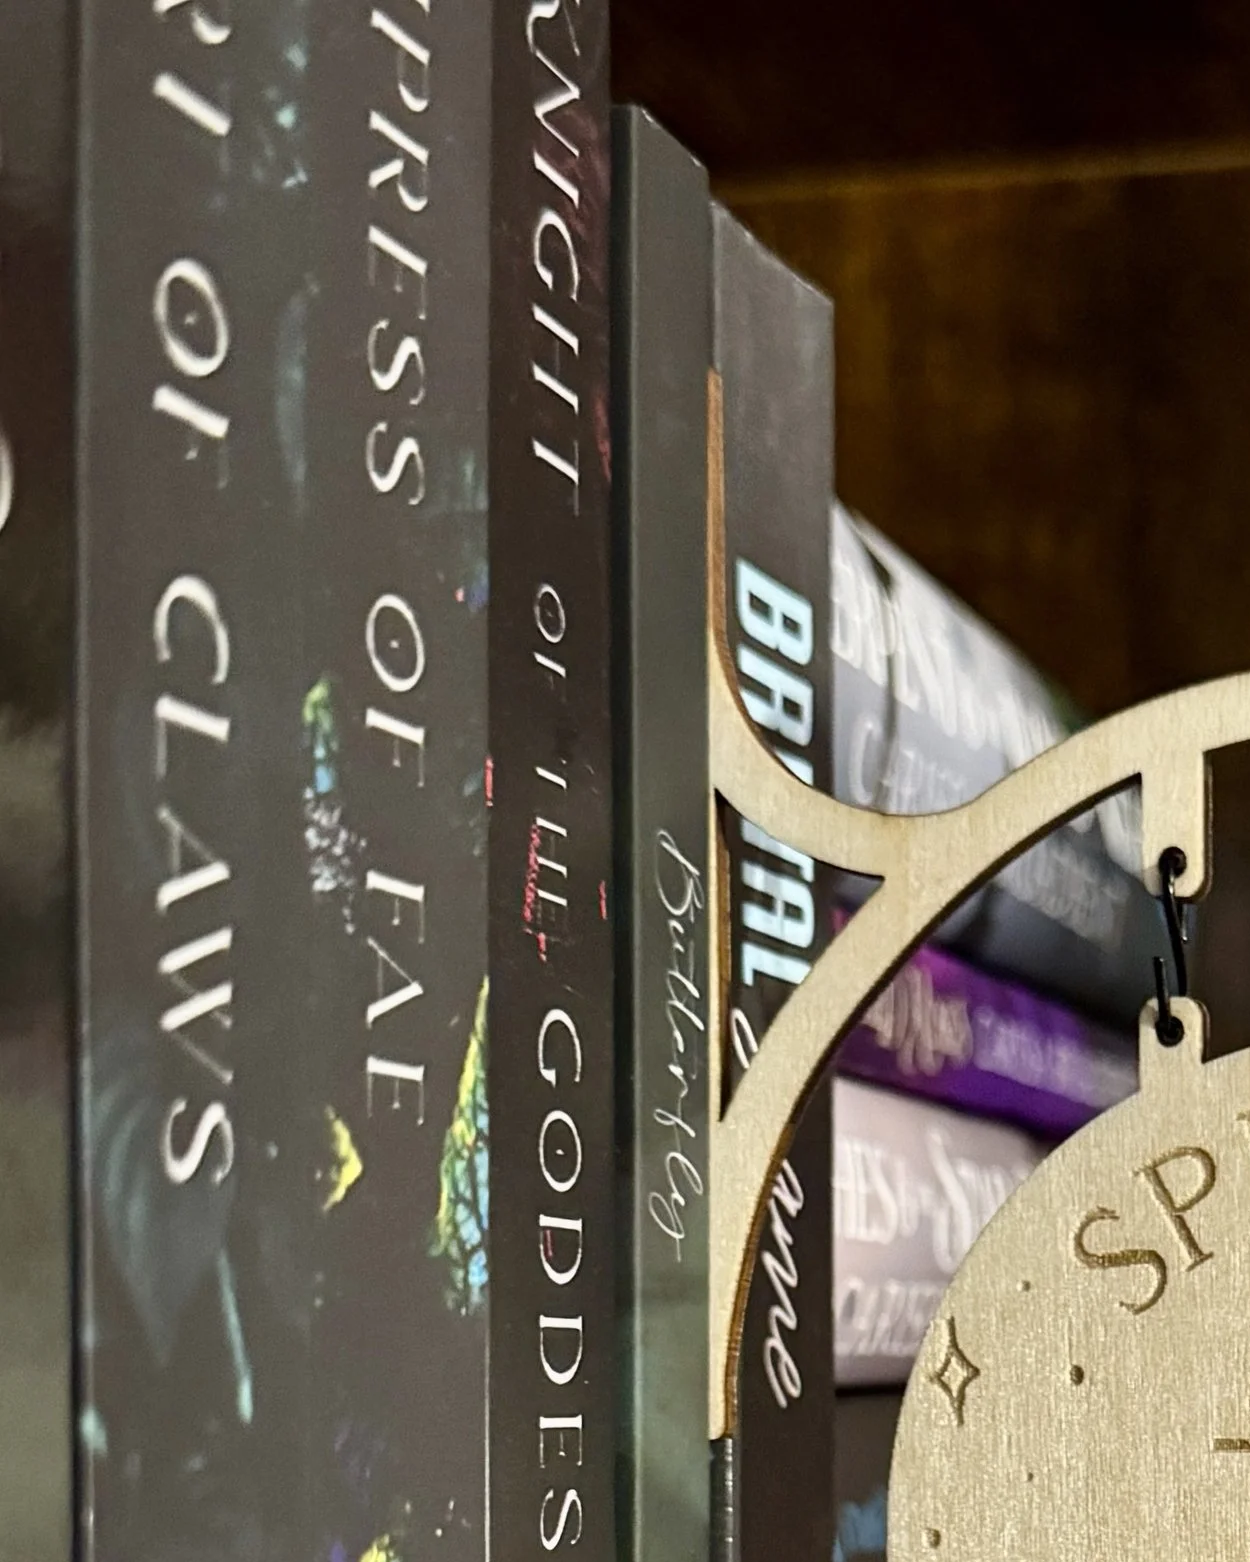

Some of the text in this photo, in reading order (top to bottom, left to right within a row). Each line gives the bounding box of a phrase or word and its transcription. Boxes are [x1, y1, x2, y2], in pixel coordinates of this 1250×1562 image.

[153, 259, 231, 488] OF
[366, 0, 431, 1126] PRESS OF FAE
[533, 757, 569, 935] THE
[534, 583, 567, 700] OF
[736, 557, 814, 986] BRTAL
[154, 576, 235, 1186] CLAWS
[650, 828, 706, 1263] Butterfly
